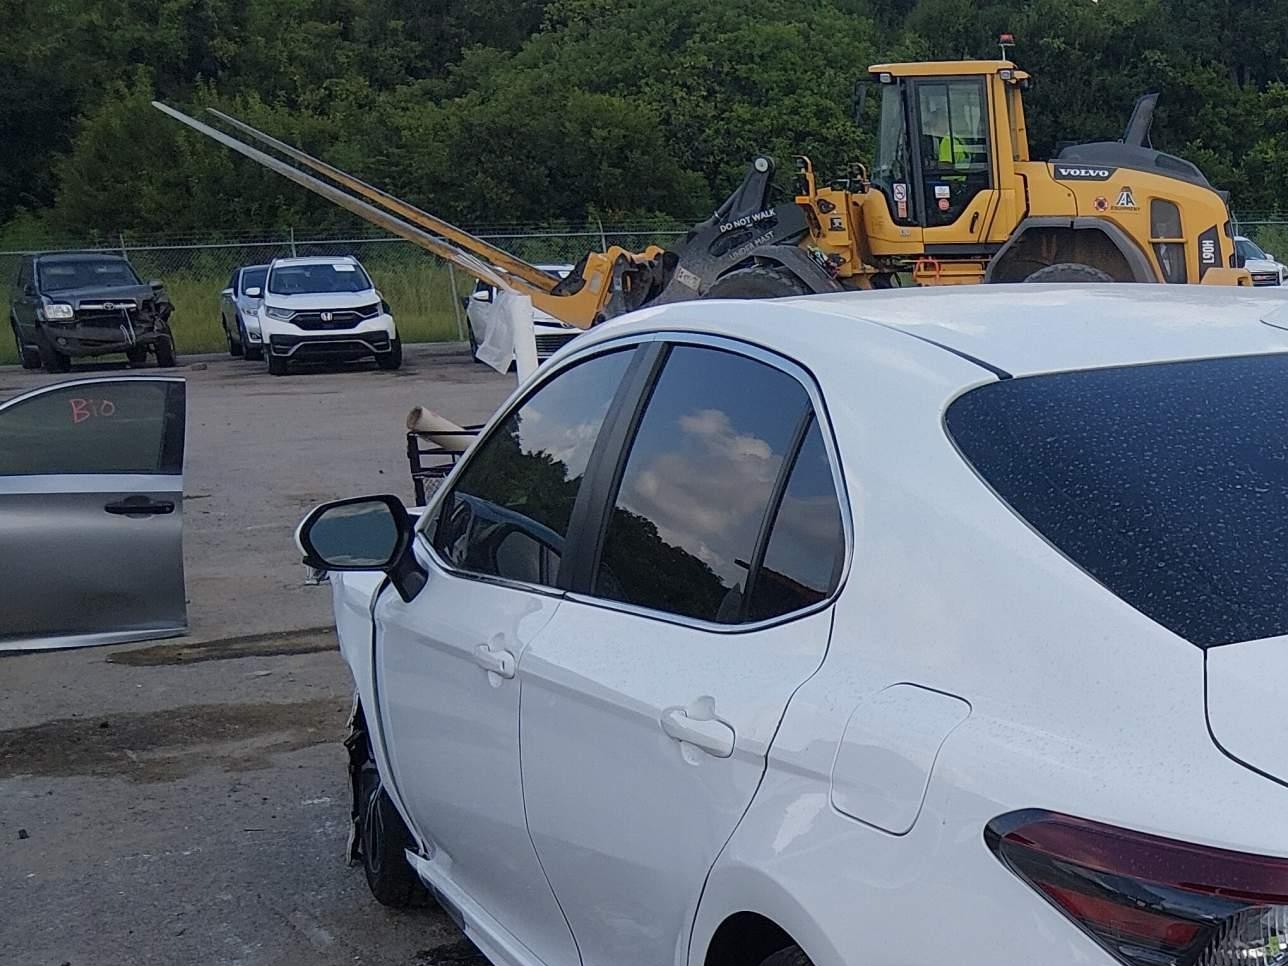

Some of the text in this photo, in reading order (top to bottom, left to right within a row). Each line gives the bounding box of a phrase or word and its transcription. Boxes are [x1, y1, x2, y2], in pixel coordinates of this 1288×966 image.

[1059, 168, 1109, 177] VOLVO
[720, 208, 776, 232] DO NOT WALK
[729, 230, 775, 259] UNDER MAST
[1202, 240, 1215, 264] L90H
